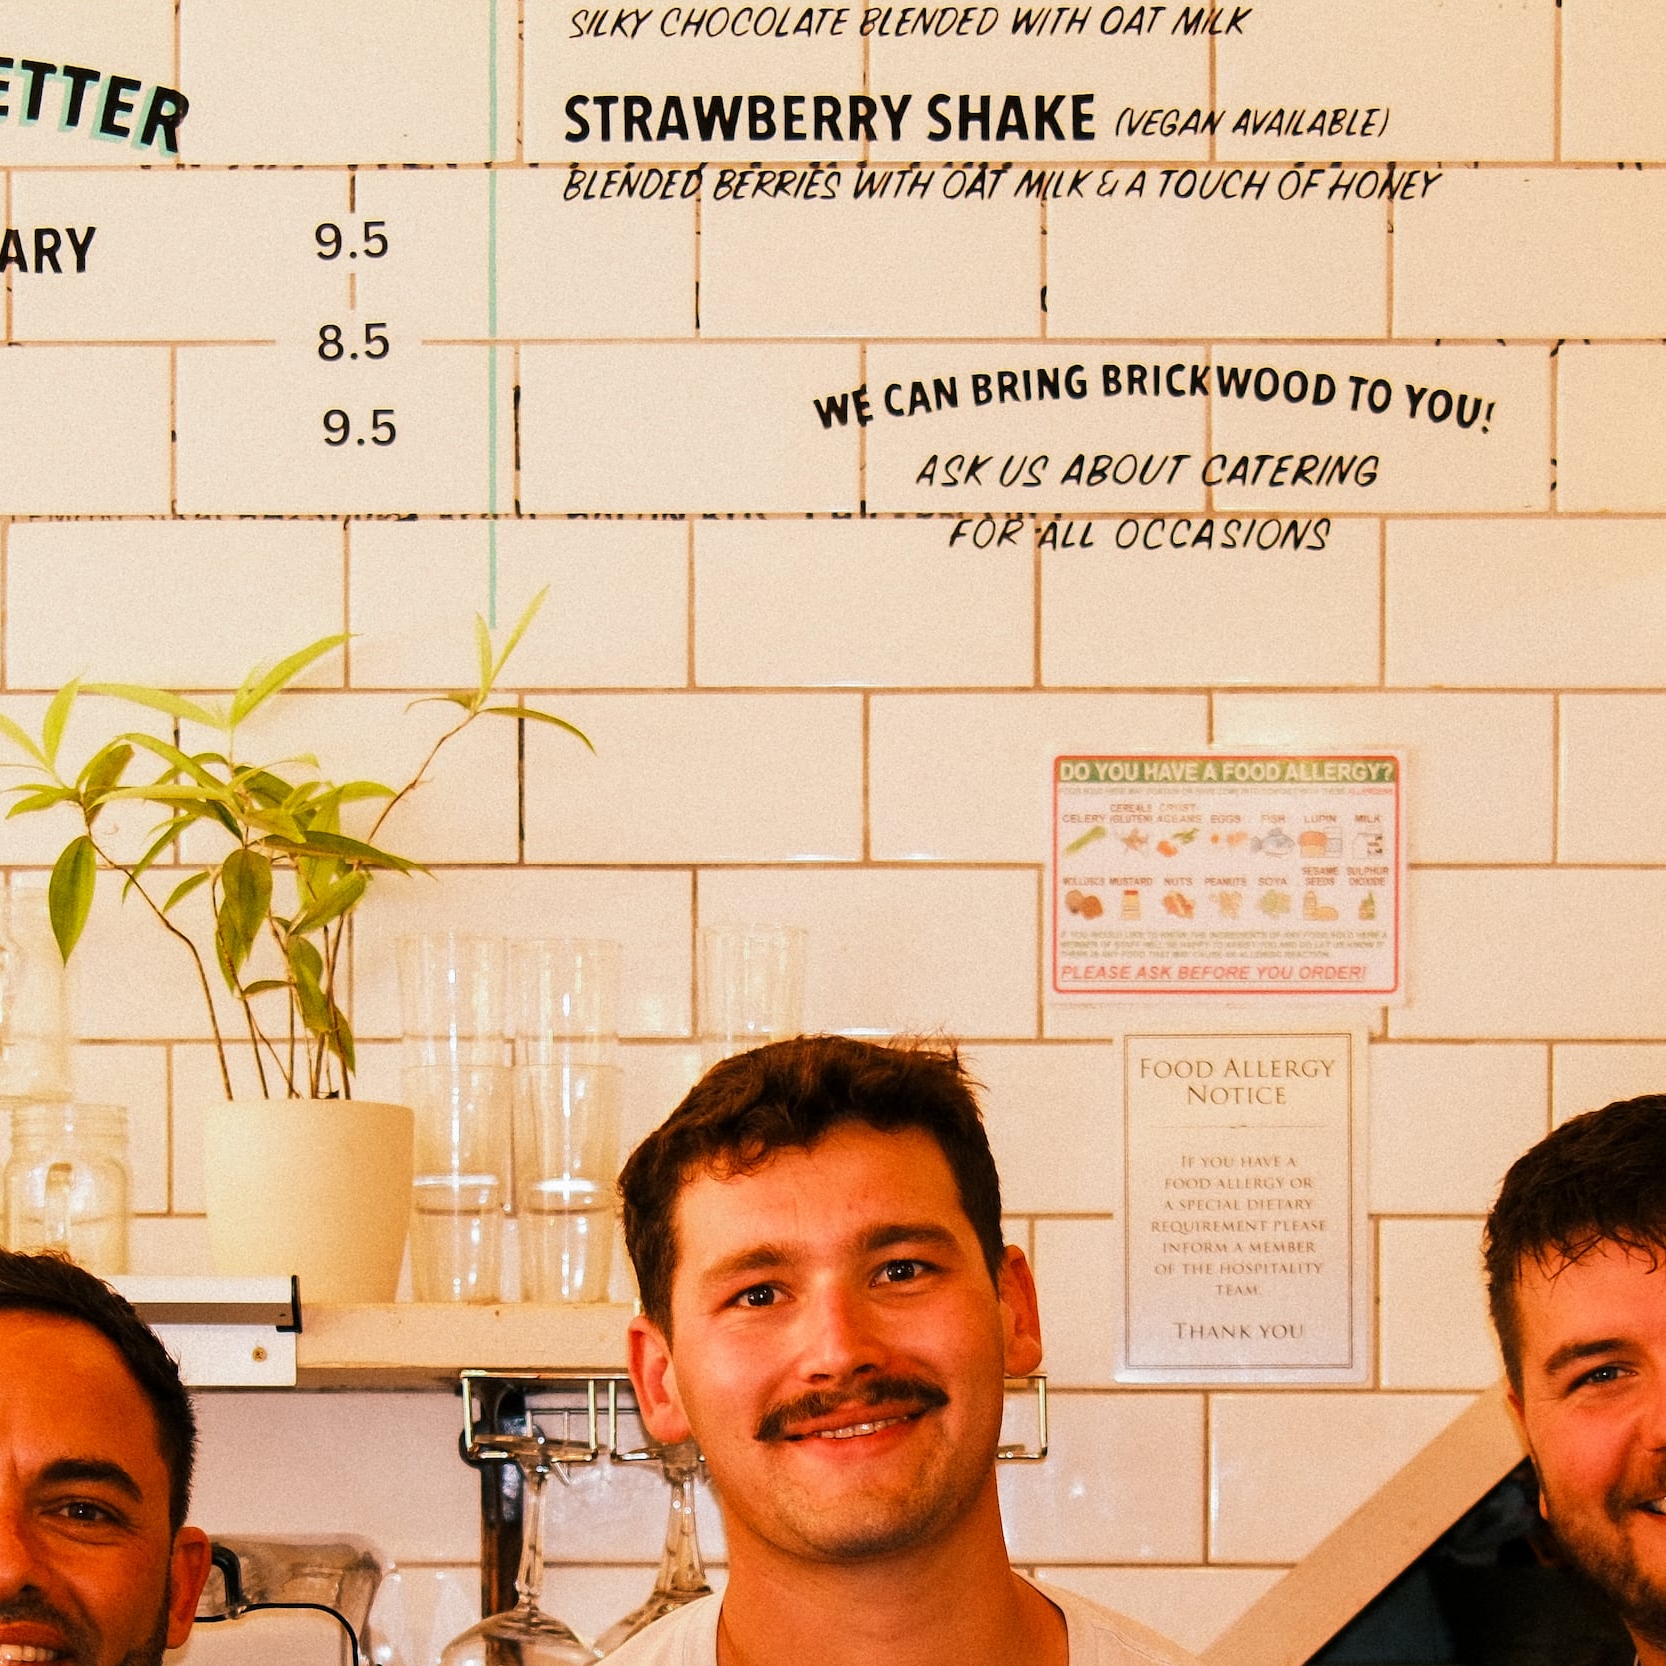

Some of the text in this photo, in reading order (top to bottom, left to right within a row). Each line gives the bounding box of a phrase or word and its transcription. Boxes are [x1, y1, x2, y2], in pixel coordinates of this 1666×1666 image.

[570, 6, 1252, 38] SILKY CHOCOLATE BLENDED WITH OAT MILK
[565, 94, 1389, 142] STRAWBERRY SHAKE (VEGAN AVAILABLE)
[564, 167, 1443, 201] BLENDED BERRIES WITH OAT MILK & A TOUCH OF HONEY
[316, 221, 388, 260] 9.5
[318, 323, 389, 361] 8.5
[813, 364, 1495, 433] WE CAN BRING BRICKWOOD TO YOU!
[324, 410, 396, 446] 9.5
[917, 454, 1379, 487] ASK US ABOUT CATERING
[950, 518, 1330, 550] FOR ALL OCCASIONS
[1061, 762, 1393, 781] DO YOU HAVE A FOOD ALLERGY?
[1062, 814, 1106, 824] CELERY
[1210, 814, 1241, 824] EGGS
[1304, 814, 1337, 824] LUPIN
[1355, 814, 1382, 824] MILK
[1346, 866, 1390, 876] SULPHUR
[1109, 877, 1153, 886] MUSTARD
[1164, 877, 1193, 886] NUTS
[1204, 877, 1247, 886] PEANUTS
[1258, 877, 1288, 886] SOYA
[1305, 877, 1335, 886] SEEDS
[1061, 965, 1368, 980] PLEASE ASK BEFORE YOU ORDER!
[1140, 1057, 1336, 1080] FOOD ALLERGY
[1187, 1085, 1287, 1105] NOTICE
[1175, 1322, 1305, 1340] THANK YOU
